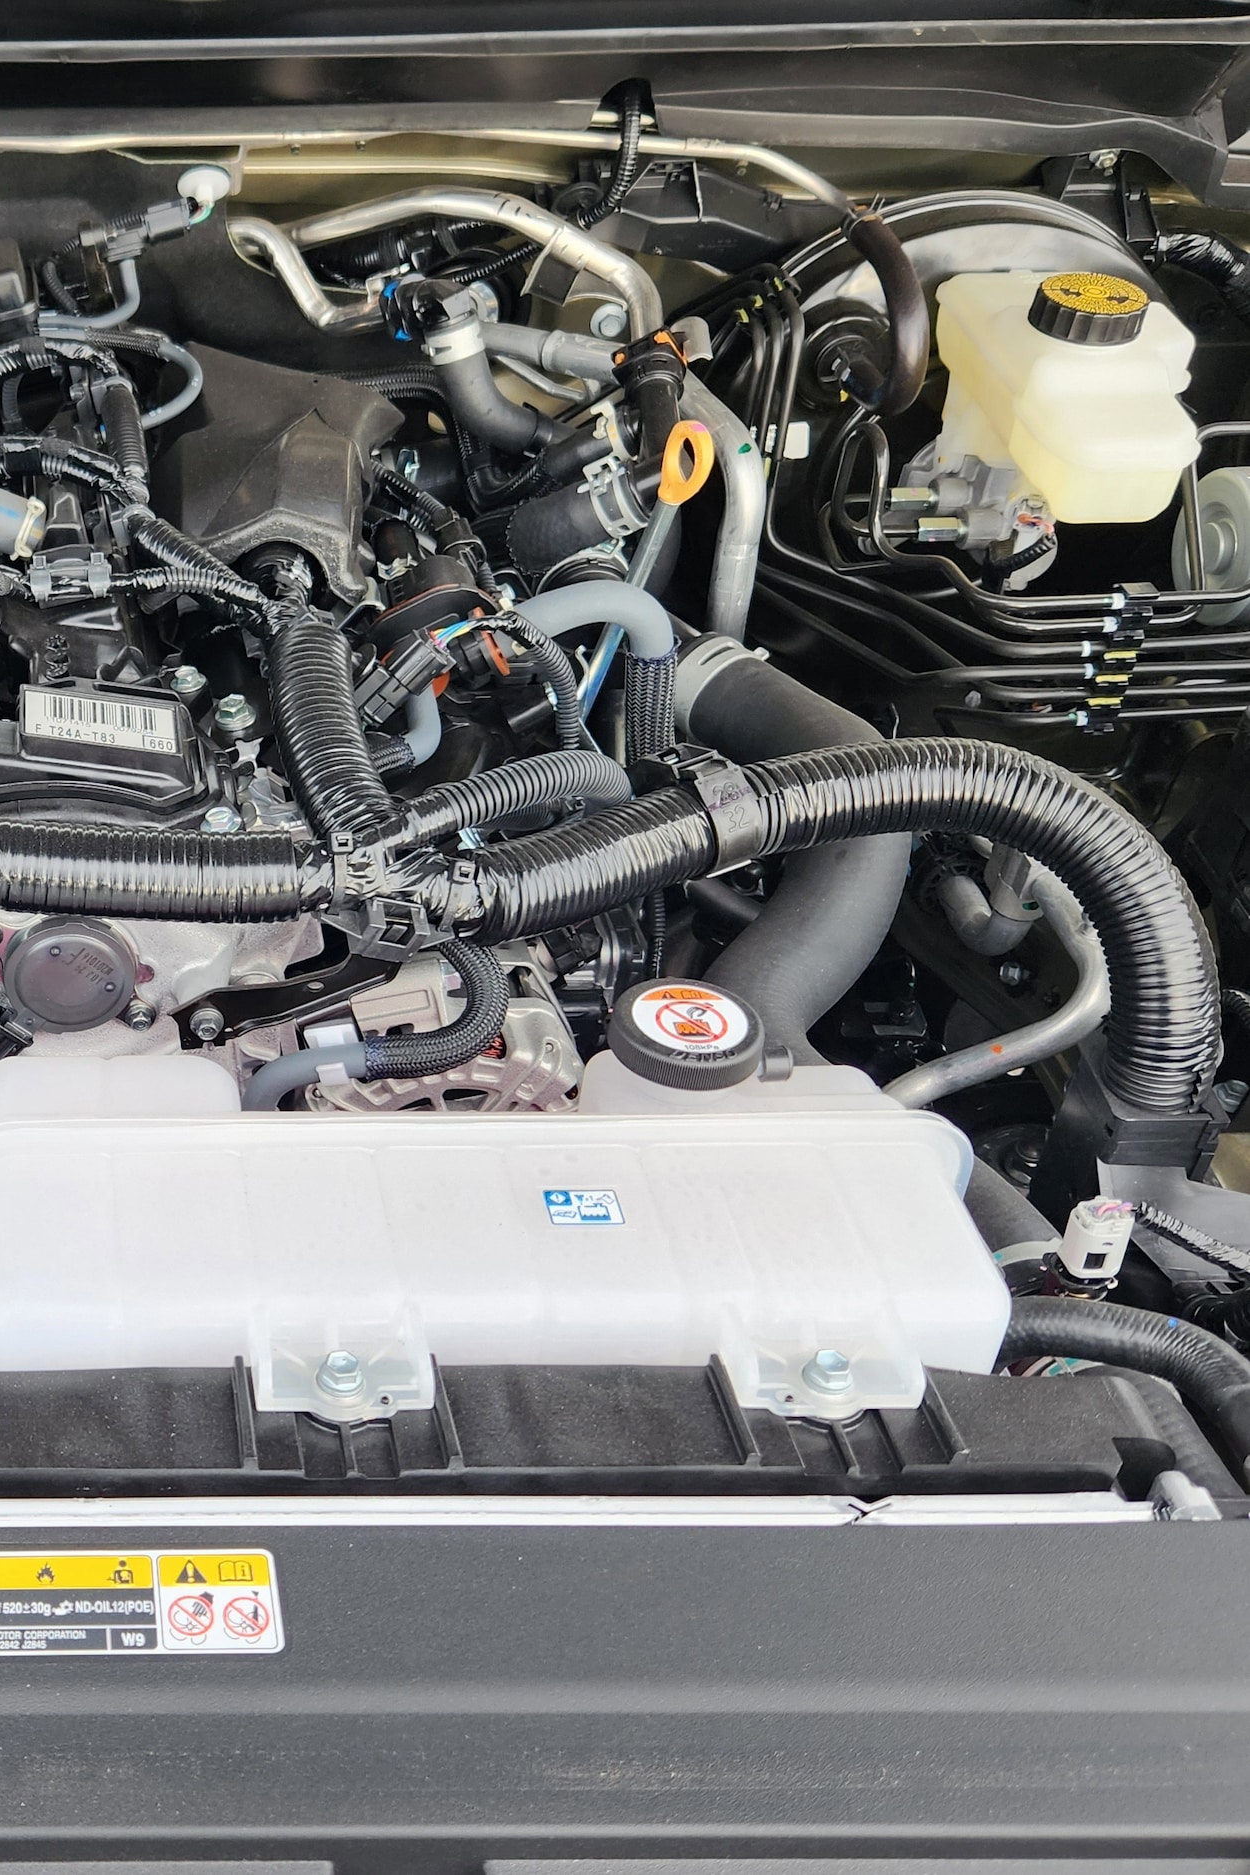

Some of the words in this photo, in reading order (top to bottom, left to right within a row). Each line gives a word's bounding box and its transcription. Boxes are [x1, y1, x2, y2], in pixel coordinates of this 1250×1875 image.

[35, 723, 42, 734] F
[49, 725, 116, 744] T24A-T83
[149, 739, 174, 751] 660
[722, 804, 751, 833] 32
[3, 1601, 52, 1617] 520±30g
[75, 1600, 155, 1616] ND-OIL12(POE)
[23, 1629, 87, 1640] CORPORATION
[120, 1631, 146, 1648] W9
